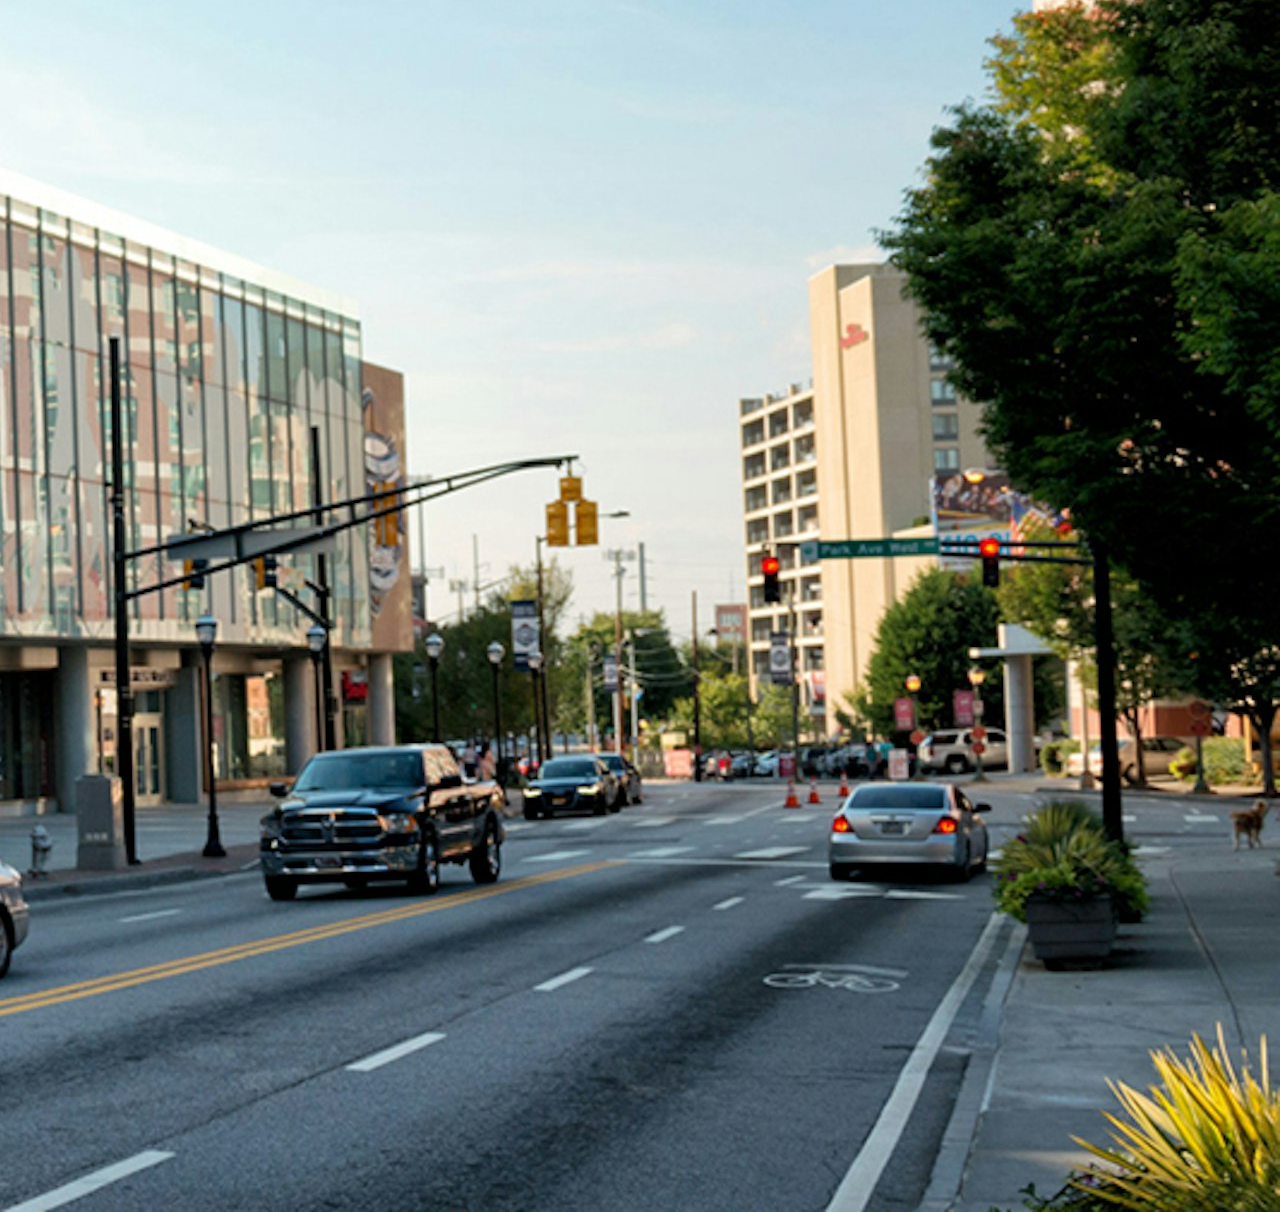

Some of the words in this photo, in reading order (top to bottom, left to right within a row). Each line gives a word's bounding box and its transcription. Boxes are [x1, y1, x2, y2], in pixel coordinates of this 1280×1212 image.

[821, 544, 851, 556] Park
[857, 543, 883, 555] Ave
[890, 541, 919, 554] West
